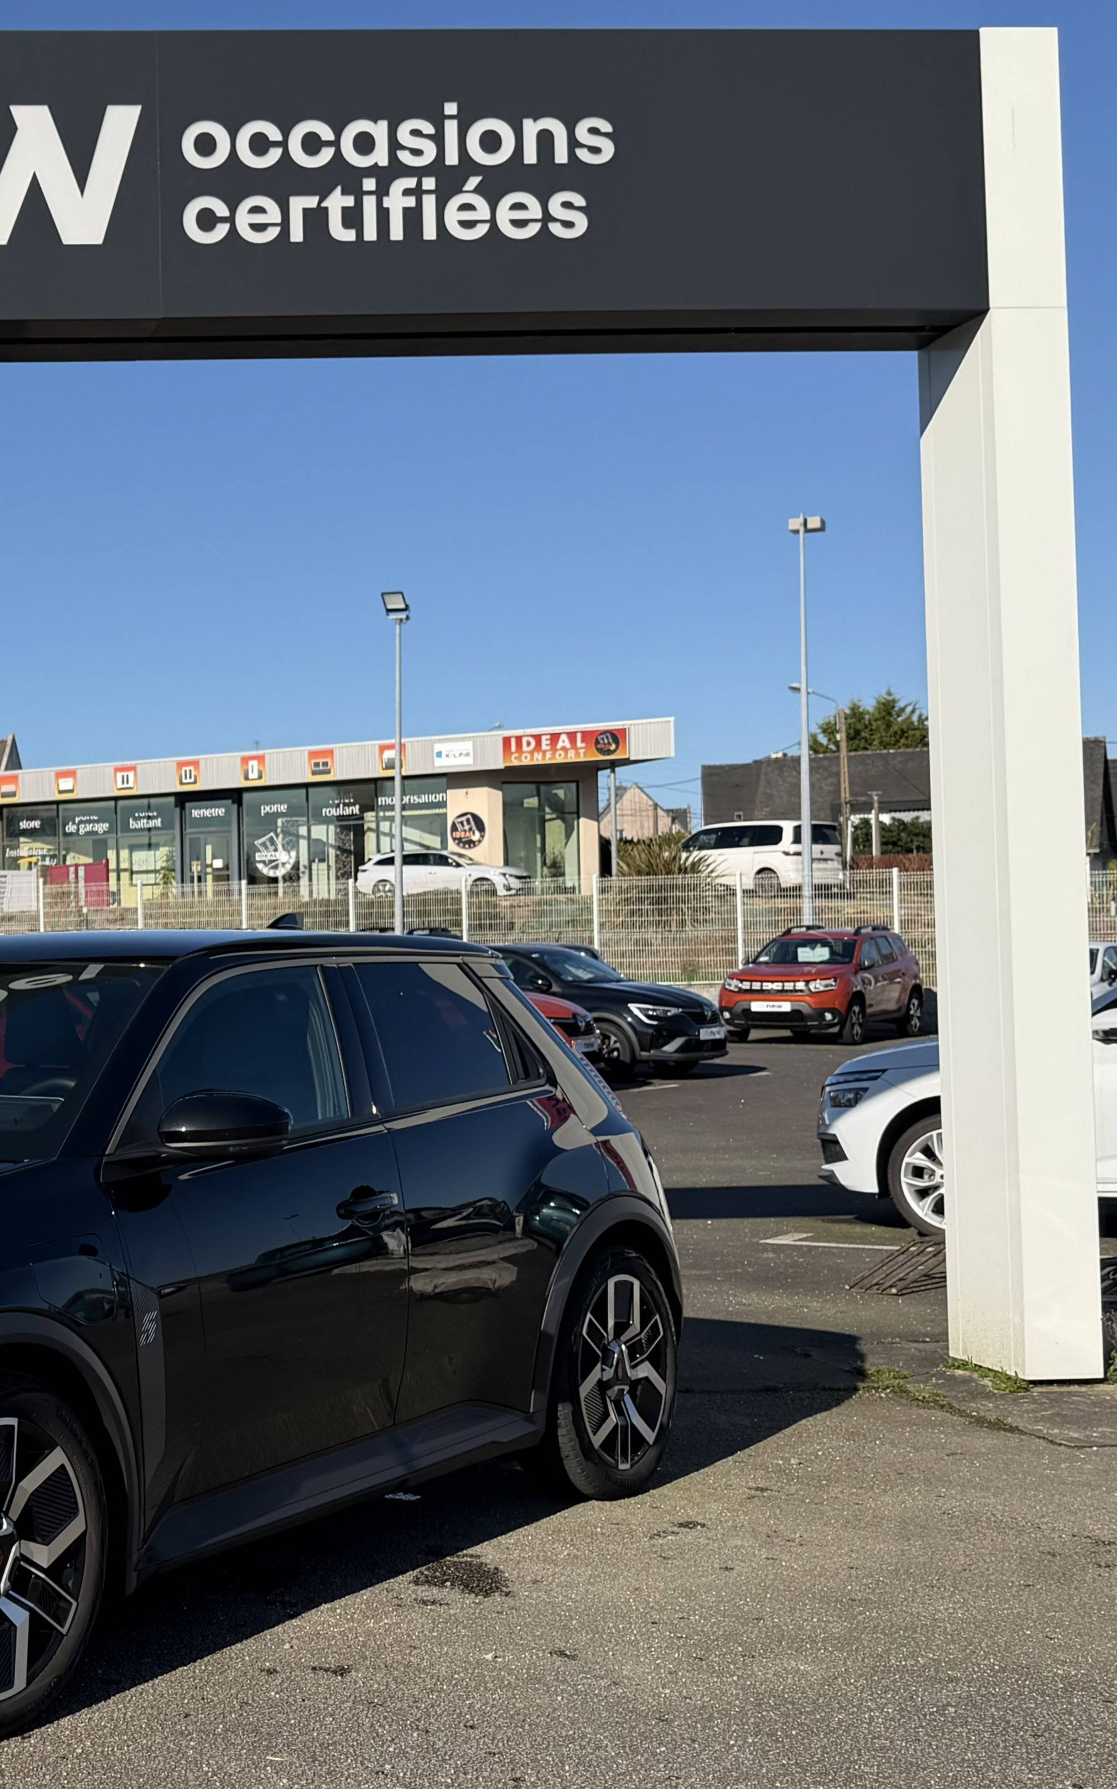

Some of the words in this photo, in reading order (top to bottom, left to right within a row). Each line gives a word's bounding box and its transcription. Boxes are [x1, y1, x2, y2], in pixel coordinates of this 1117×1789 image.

[181, 102, 616, 169] occasions
[182, 175, 589, 244] certifiées
[510, 731, 587, 753] IDEAL
[510, 748, 587, 764] CONFORT
[378, 792, 447, 806] moorisation
[322, 803, 361, 817] roulant
[19, 819, 41, 830] store
[65, 821, 77, 834] de
[79, 822, 110, 836] garage
[129, 817, 163, 830] battant
